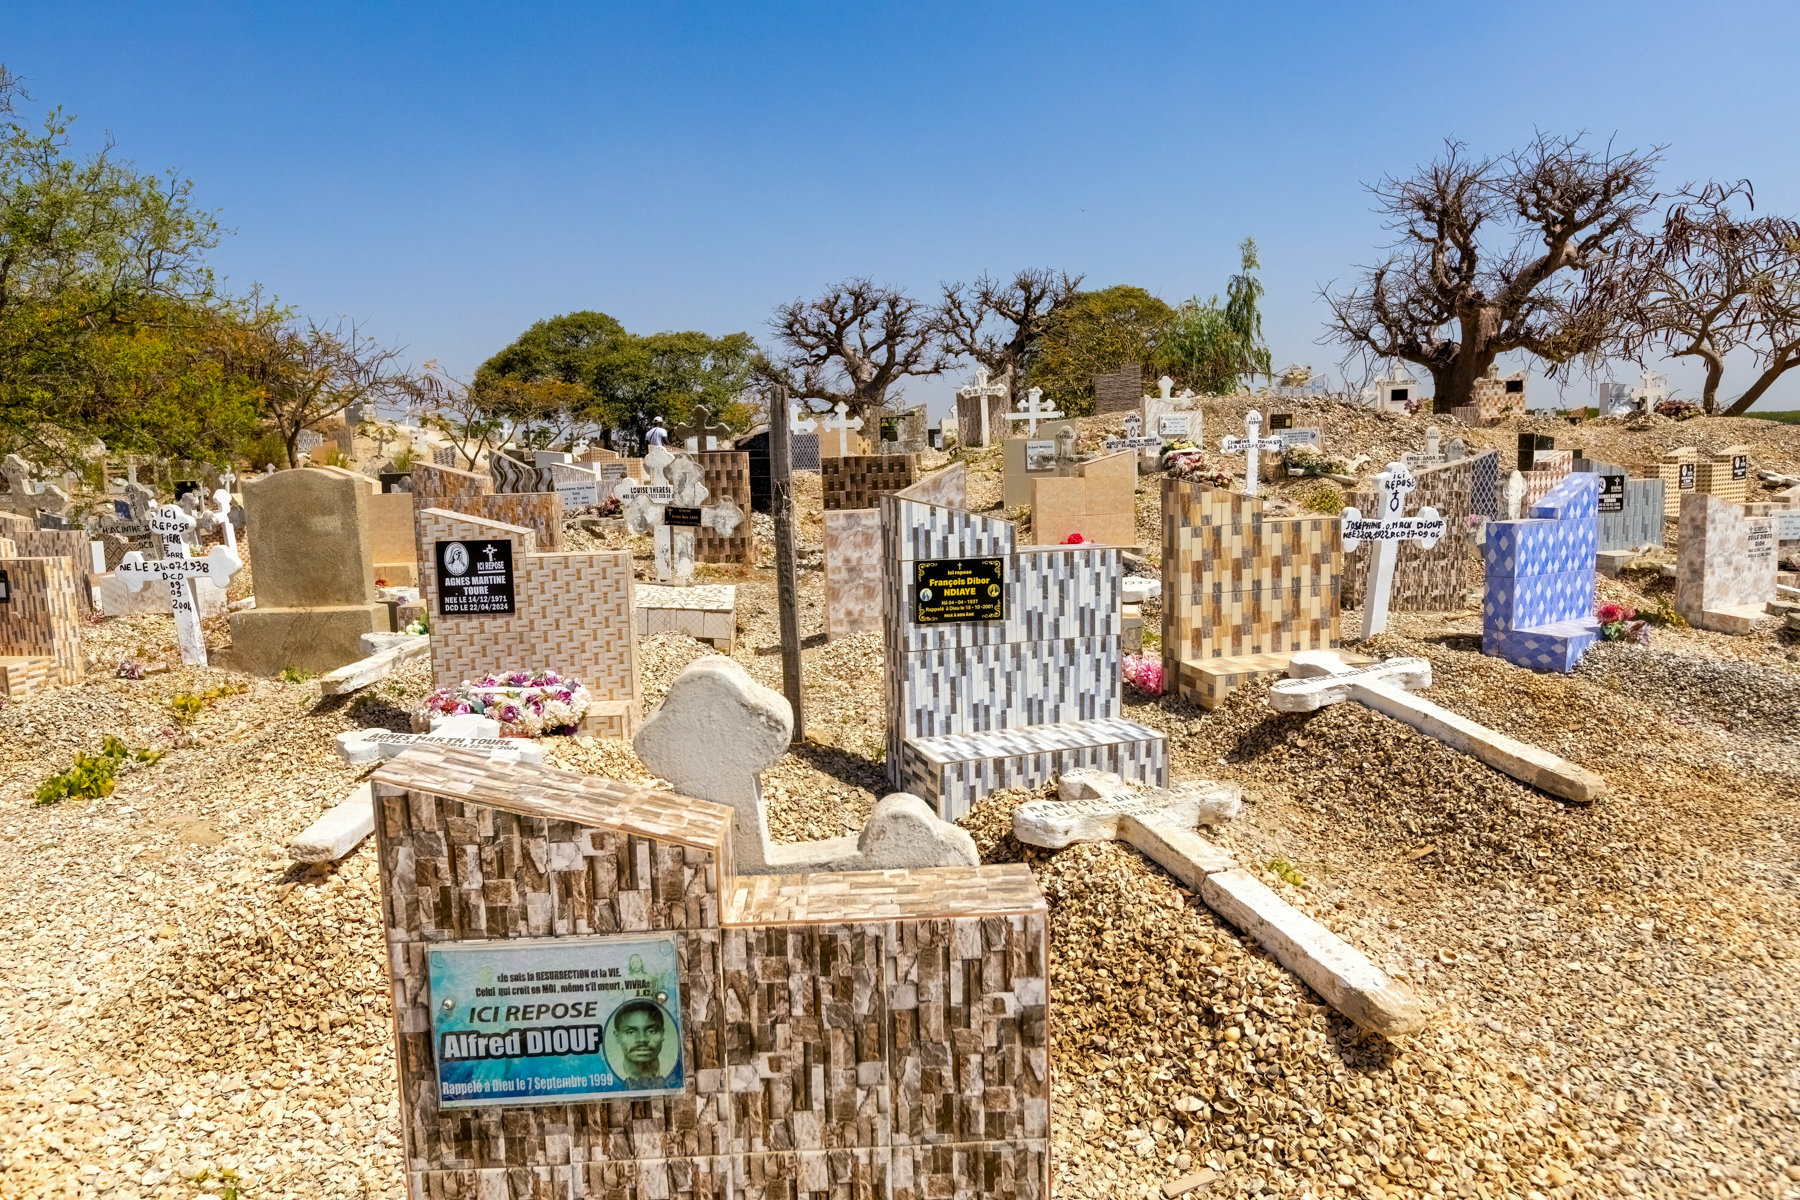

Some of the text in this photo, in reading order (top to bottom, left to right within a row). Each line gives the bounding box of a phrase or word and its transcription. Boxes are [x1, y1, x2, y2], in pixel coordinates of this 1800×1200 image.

[1385, 478, 1416, 490] REPOSE
[160, 508, 176, 520] ICI
[152, 520, 190, 533] REPOSE
[120, 564, 132, 572] NE
[135, 562, 149, 572] LE
[477, 561, 505, 570] ICI REPOSE
[445, 575, 506, 586] AGNES MARTINE
[929, 577, 990, 588] François Dibor
[463, 586, 489, 596] TOURE
[944, 588, 976, 597] NDIAYE
[459, 596, 467, 604] LE
[468, 595, 508, 604] 14/12/1971
[445, 604, 459, 612] DCD
[470, 603, 509, 612] 22/04/2024
[368, 733, 414, 741] AGNES
[469, 737, 513, 747] TOURE
[510, 973, 526, 982] suis
[527, 972, 535, 982] la
[536, 969, 590, 981] RESURRECTION
[591, 970, 598, 978] et
[600, 969, 607, 978] la
[476, 987, 496, 997] Celui
[499, 986, 511, 997] qui
[512, 985, 530, 996] croit
[531, 986, 541, 994] en
[561, 983, 584, 993] même
[469, 1001, 598, 1023] ICI REPOSE
[444, 1028, 599, 1058] Alfred DIOUF
[442, 1073, 614, 1096] Rappelé à Dieu le 7 Septembre 1999
